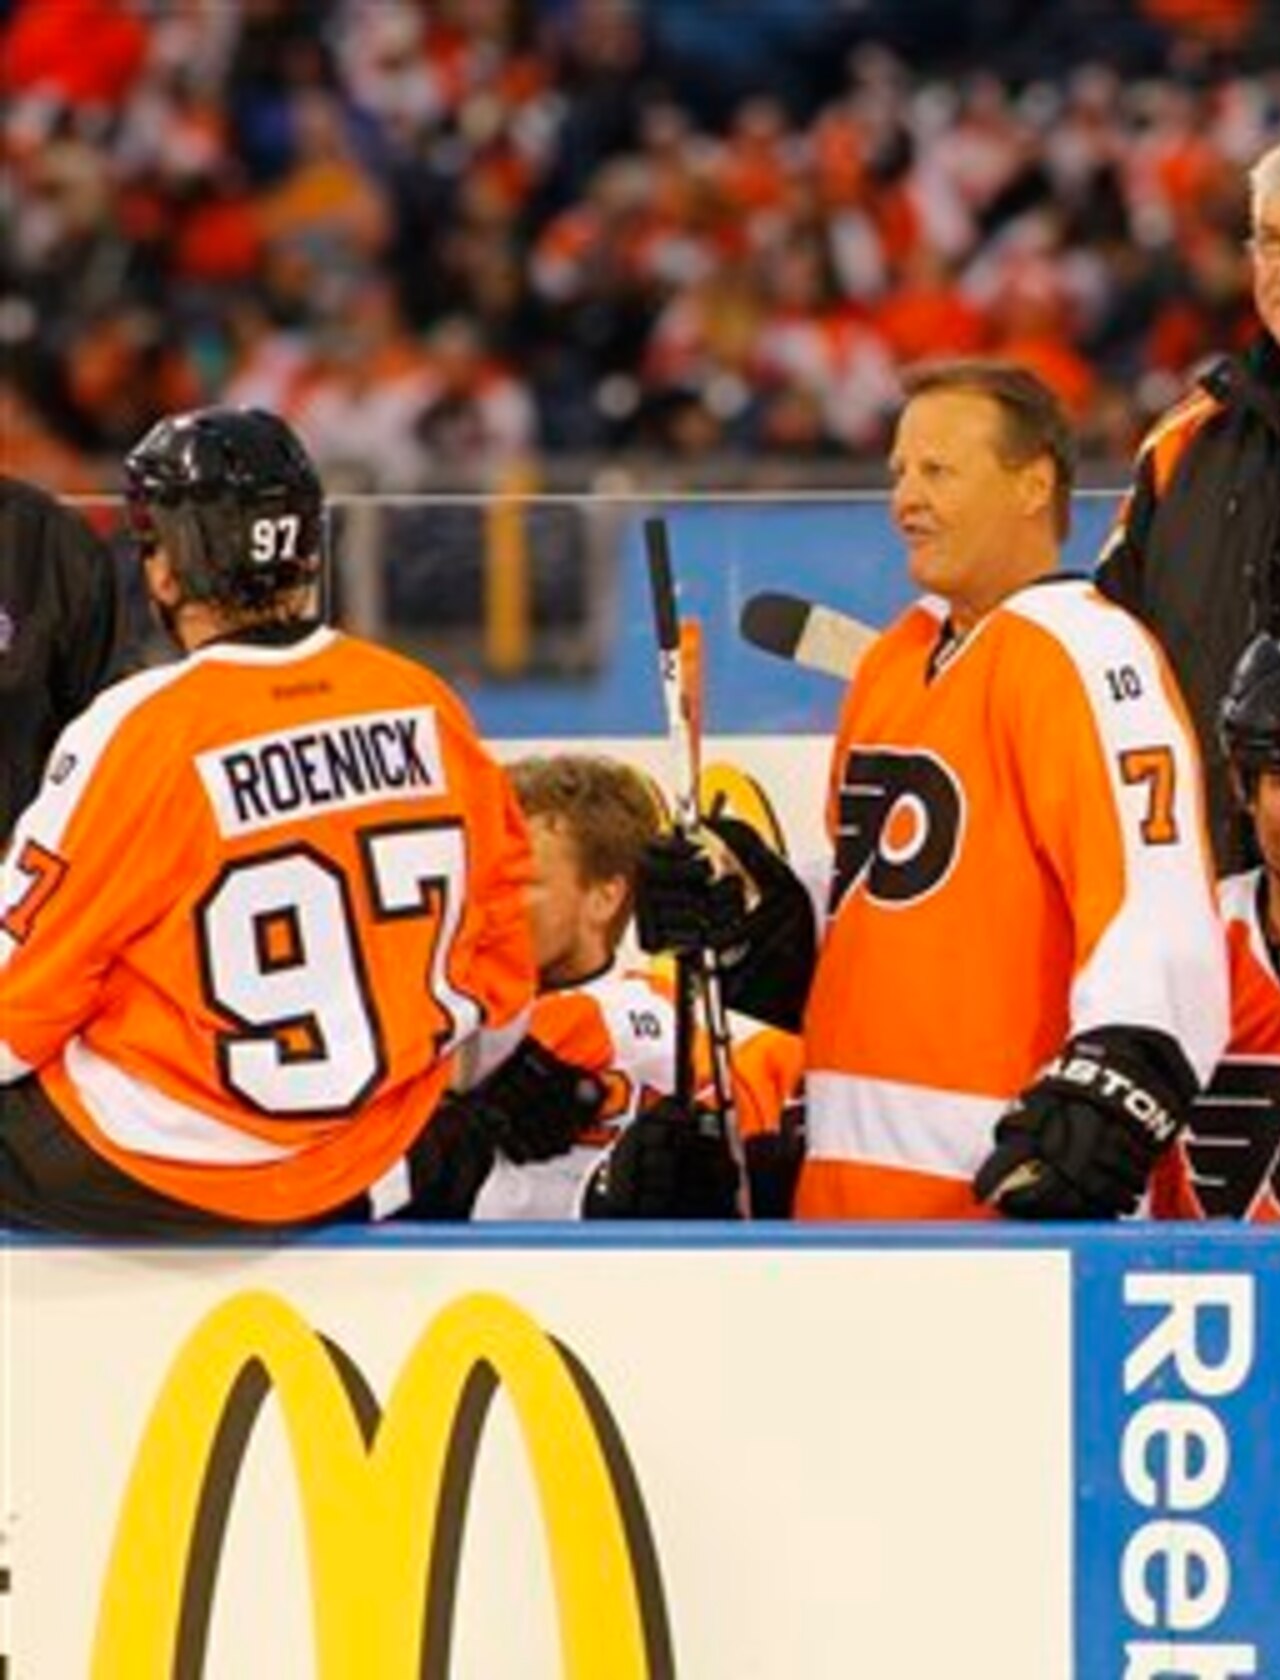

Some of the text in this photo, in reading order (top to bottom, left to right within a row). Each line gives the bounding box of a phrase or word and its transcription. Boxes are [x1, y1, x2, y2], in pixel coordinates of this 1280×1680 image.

[251, 513, 301, 563] 97
[1104, 664, 1144, 702] 10
[222, 716, 433, 823] ROENICK
[1117, 743, 1178, 844] 7
[194, 816, 487, 1121] 97
